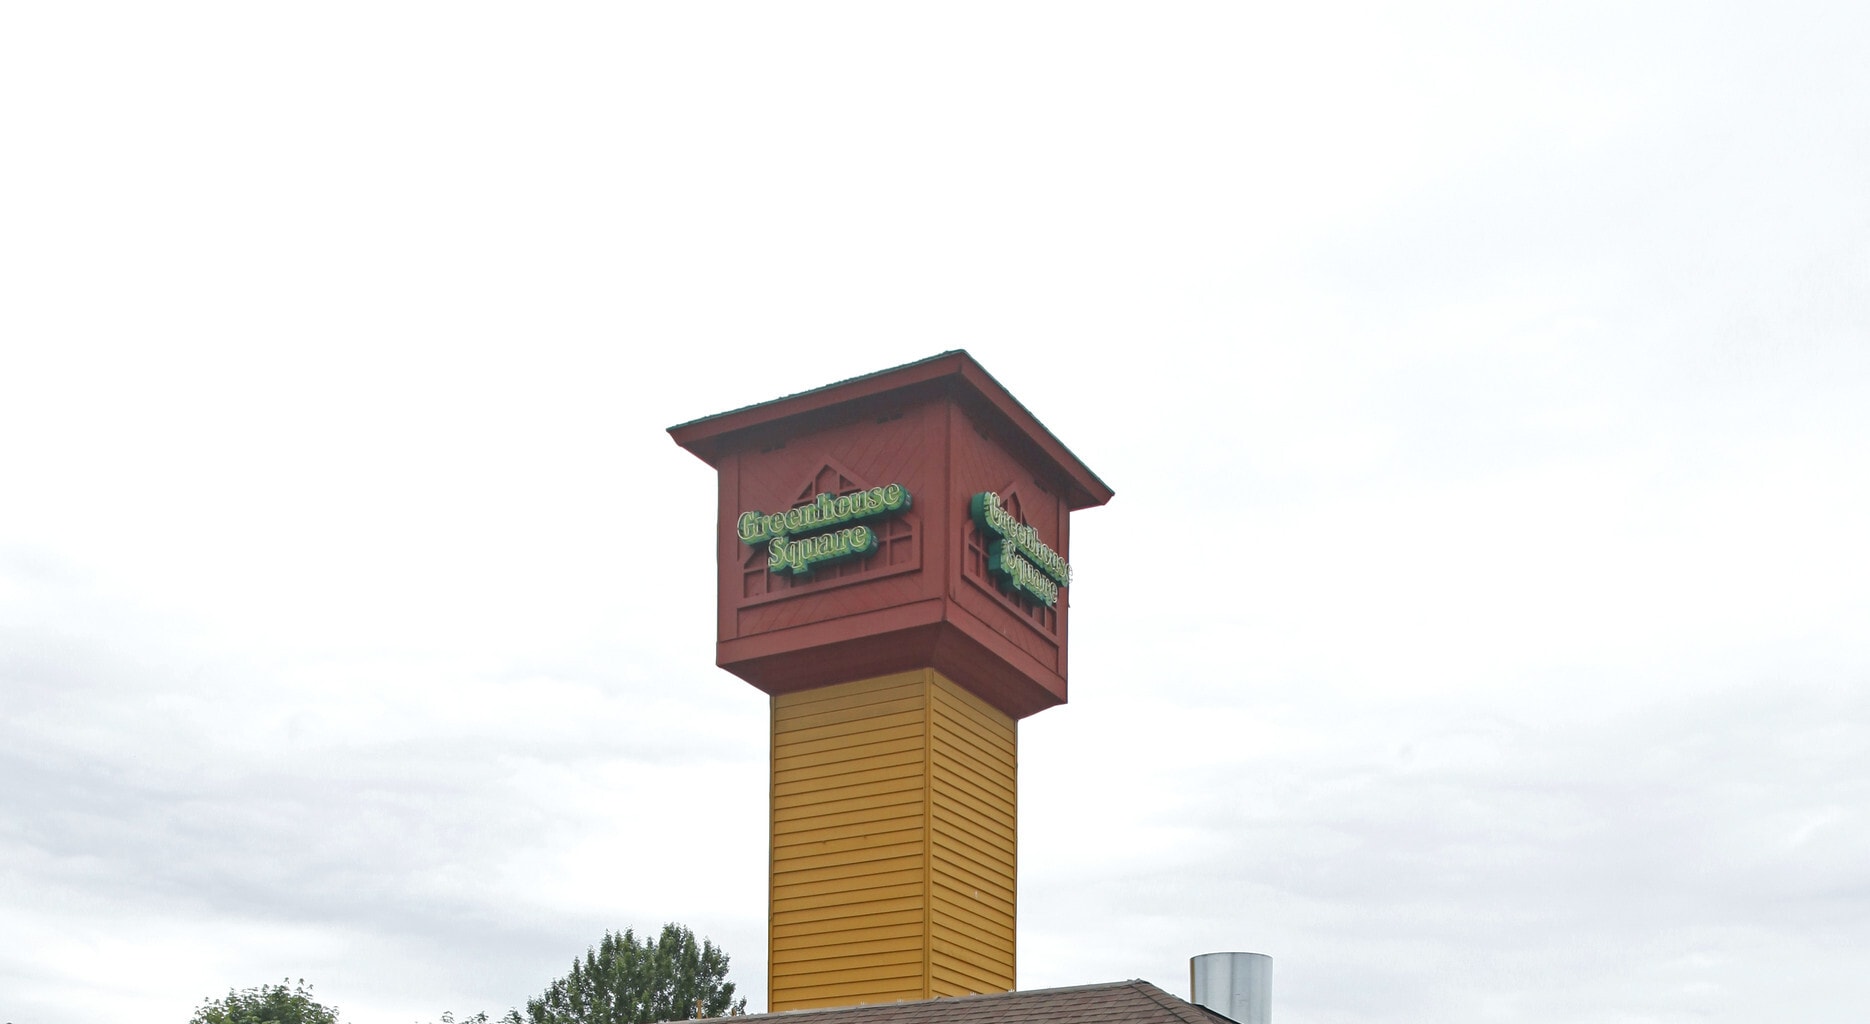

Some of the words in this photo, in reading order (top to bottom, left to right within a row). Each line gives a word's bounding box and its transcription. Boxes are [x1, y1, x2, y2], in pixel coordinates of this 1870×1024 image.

[737, 483, 902, 541] Greenhouse
[989, 491, 1073, 585] Greenhouse
[768, 525, 868, 570] Square
[1005, 539, 1058, 603] Square
